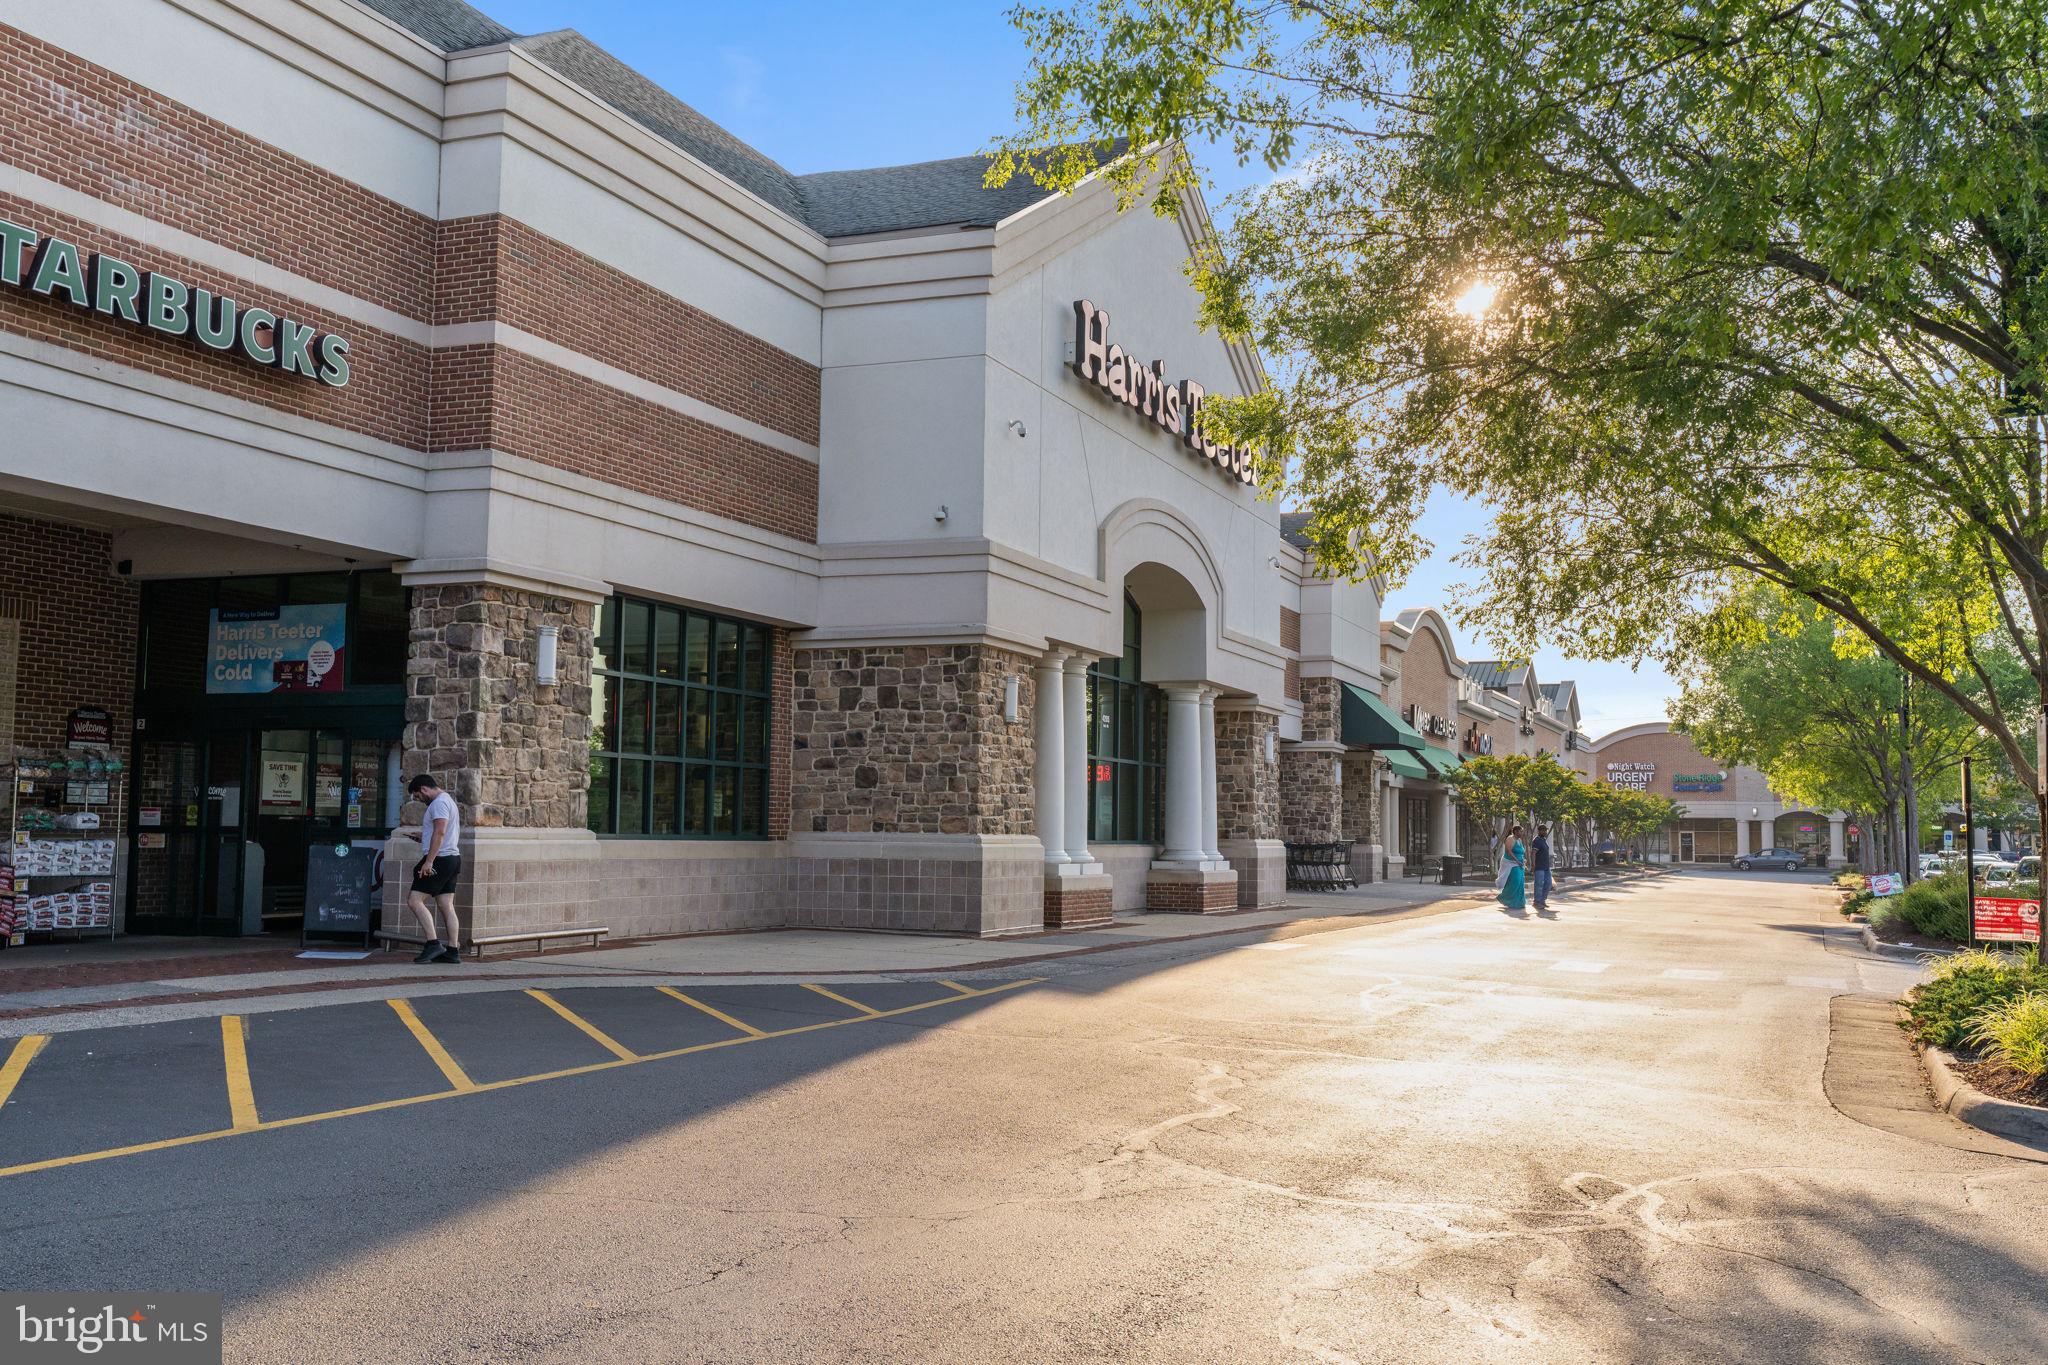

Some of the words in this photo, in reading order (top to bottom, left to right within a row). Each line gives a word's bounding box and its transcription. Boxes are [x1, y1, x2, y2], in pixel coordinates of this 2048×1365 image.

[0, 218, 351, 388] TARBUCKS
[1073, 299, 1182, 434] Harris
[217, 623, 265, 641] Harris
[269, 622, 324, 640] Teeter
[215, 643, 284, 661] Delivers
[214, 663, 253, 681] Cold
[73, 721, 108, 735] Welcome
[268, 763, 284, 771] SAVE
[284, 764, 298, 772] TIME
[1613, 762, 1633, 772] Night
[1634, 762, 1656, 771] Watch
[1607, 772, 1655, 782] URGENT
[1673, 772, 1697, 783] Stone
[1698, 772, 1723, 784] Ridge
[1615, 782, 1647, 792] CARE
